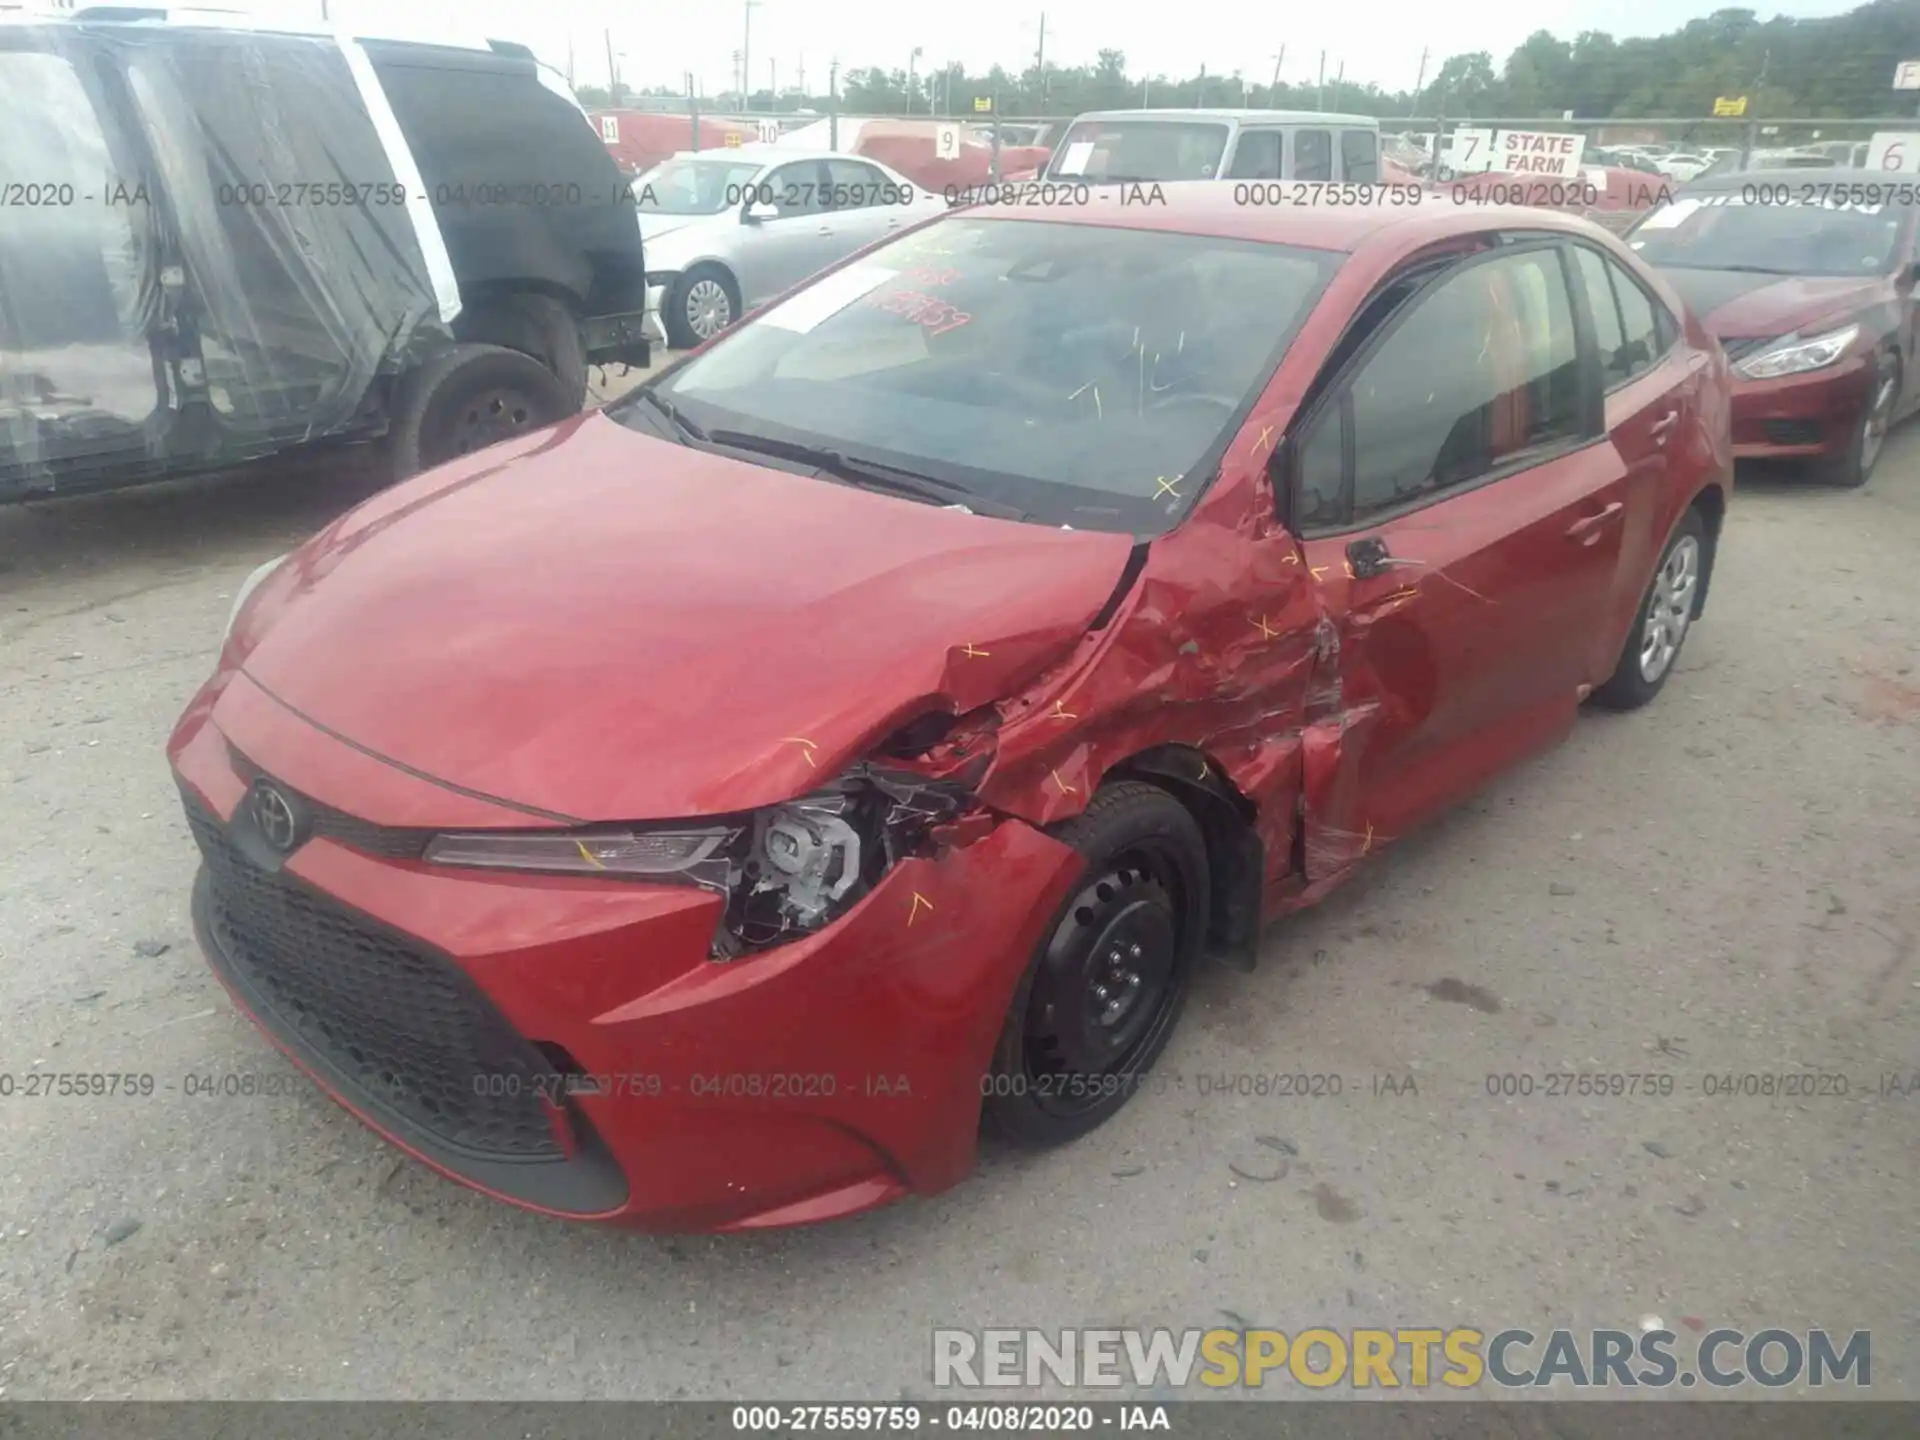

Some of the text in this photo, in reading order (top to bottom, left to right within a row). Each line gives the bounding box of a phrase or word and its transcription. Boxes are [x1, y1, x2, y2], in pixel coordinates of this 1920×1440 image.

[759, 125, 777, 144] 10
[943, 131, 953, 151] 9
[1505, 133, 1575, 154] STATE
[1464, 136, 1480, 162] 7
[1881, 142, 1906, 171] 6
[1505, 154, 1566, 174] FARM
